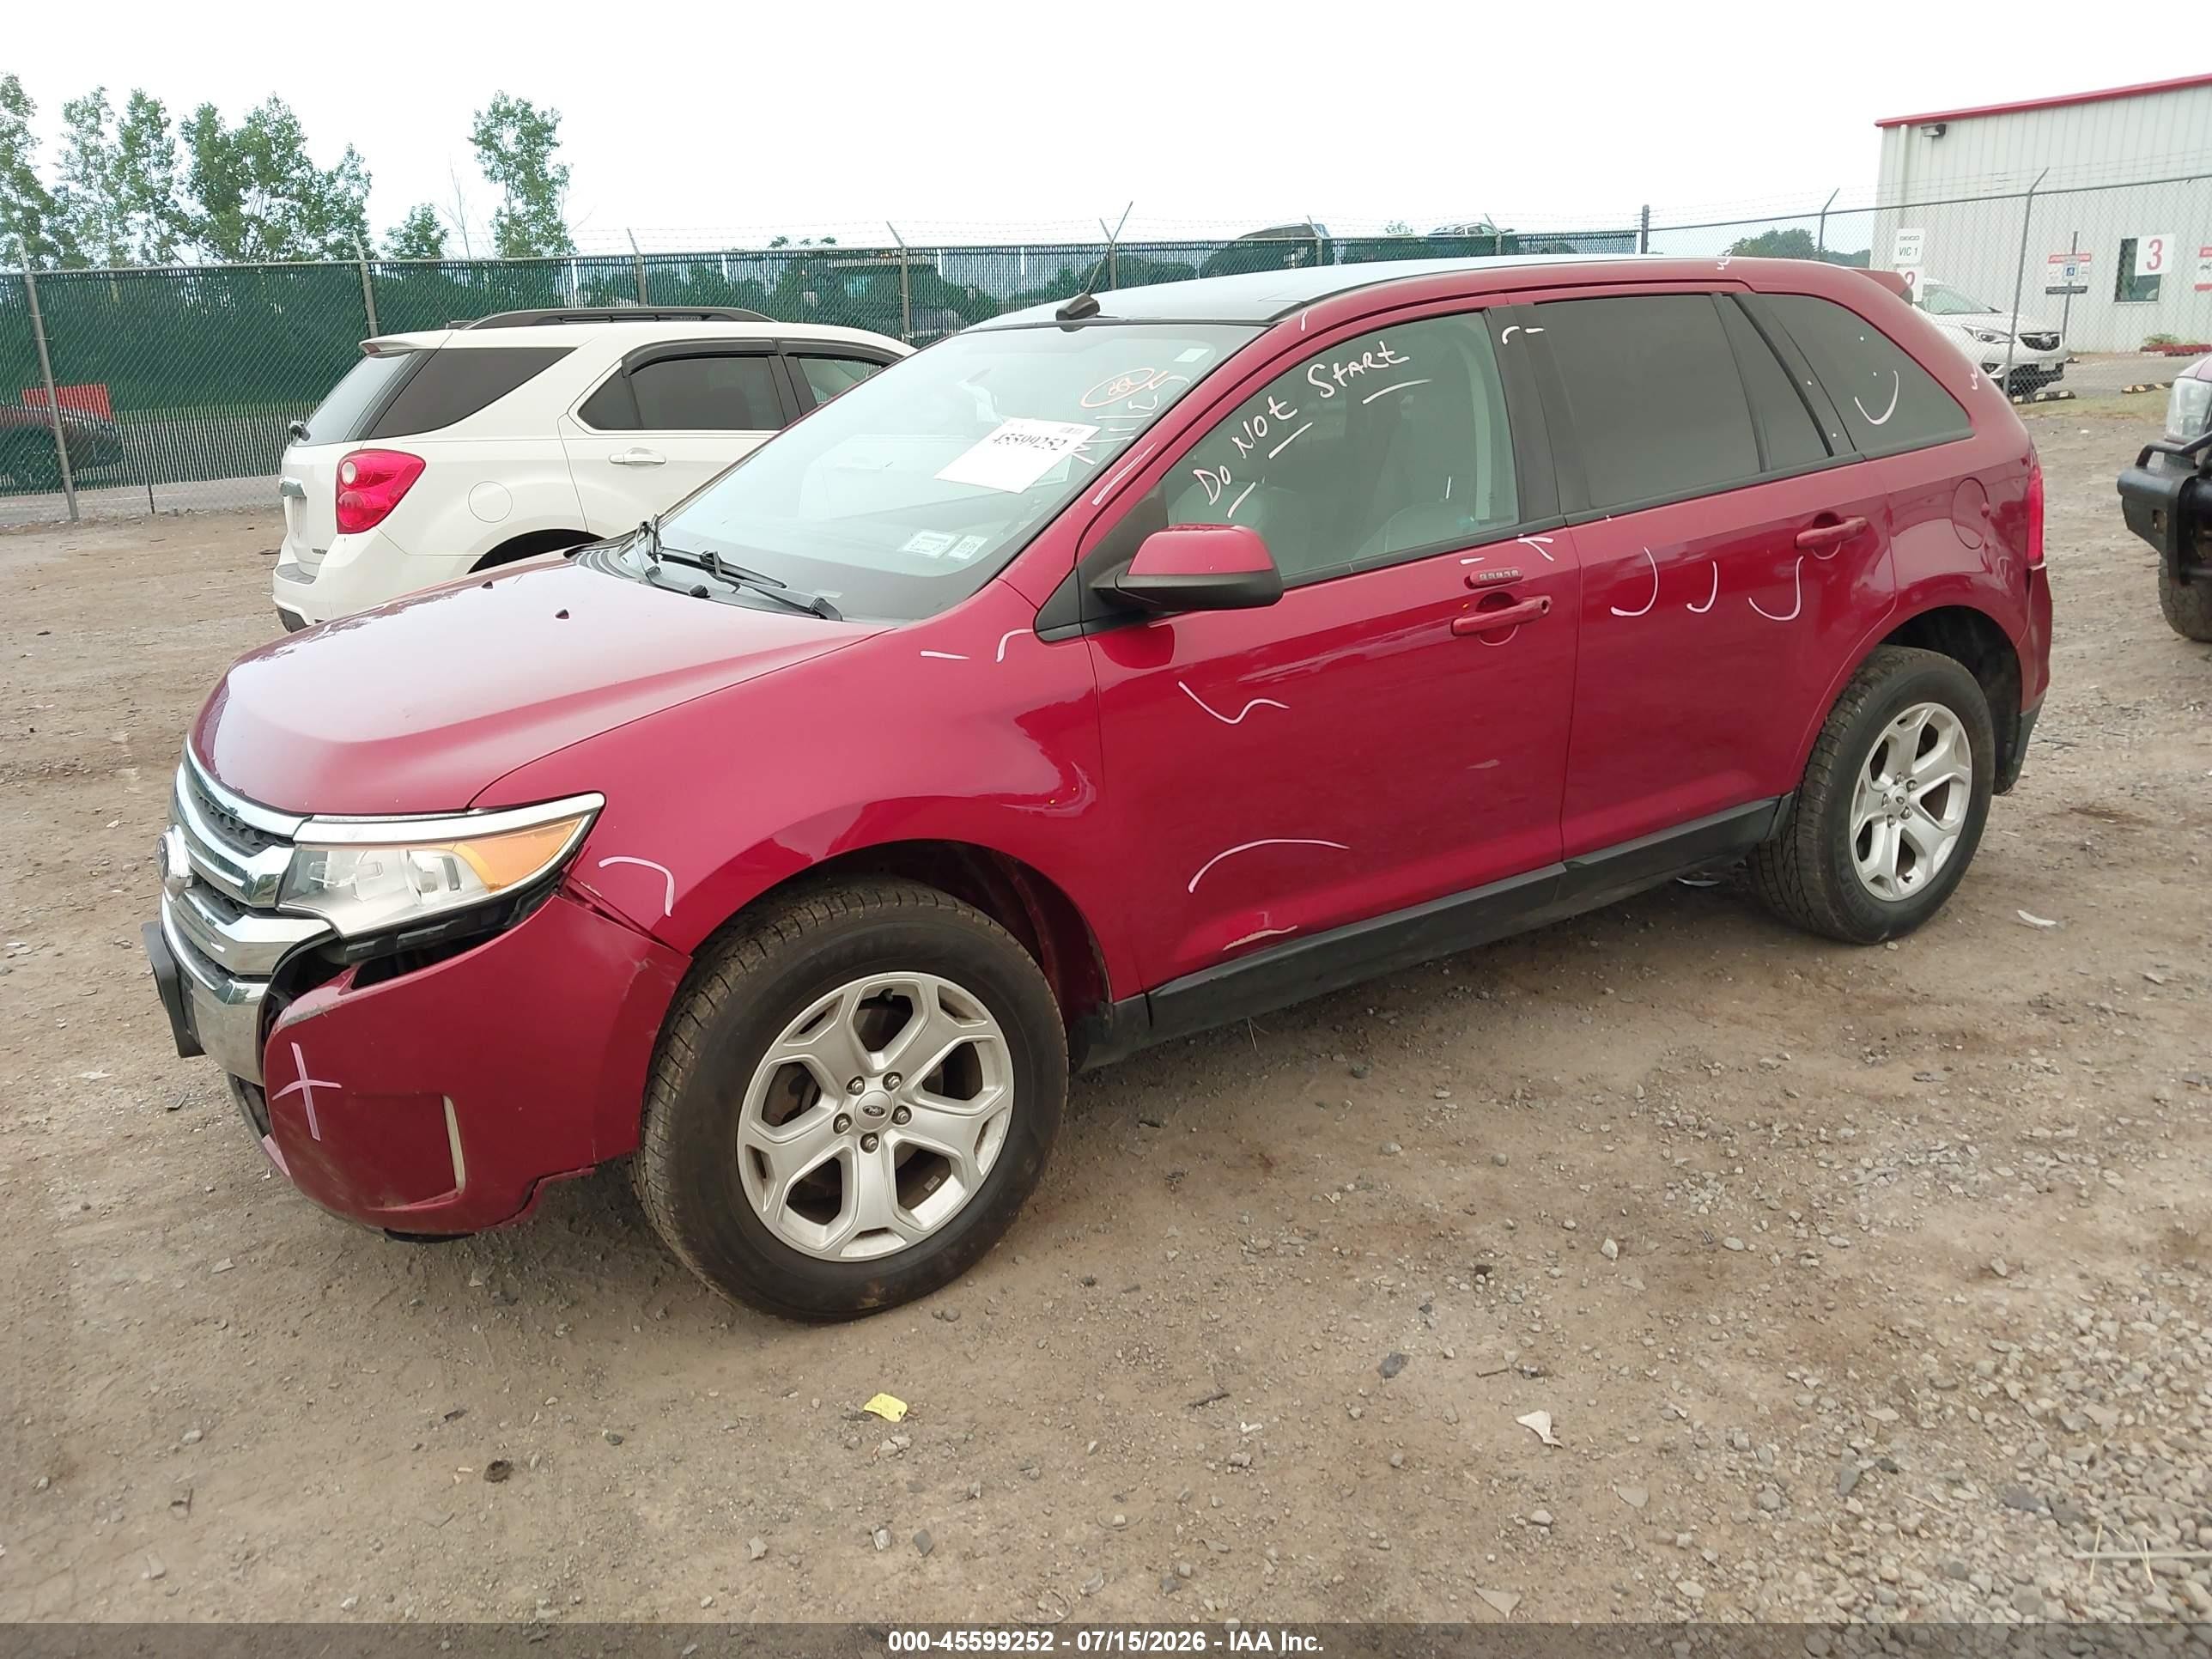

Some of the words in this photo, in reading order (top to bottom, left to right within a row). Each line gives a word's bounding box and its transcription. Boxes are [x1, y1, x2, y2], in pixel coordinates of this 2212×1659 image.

[1899, 246, 1911, 256] VIC
[1914, 246, 1918, 256] 1
[2147, 239, 2163, 270] 3
[1193, 465, 1231, 506] Do
